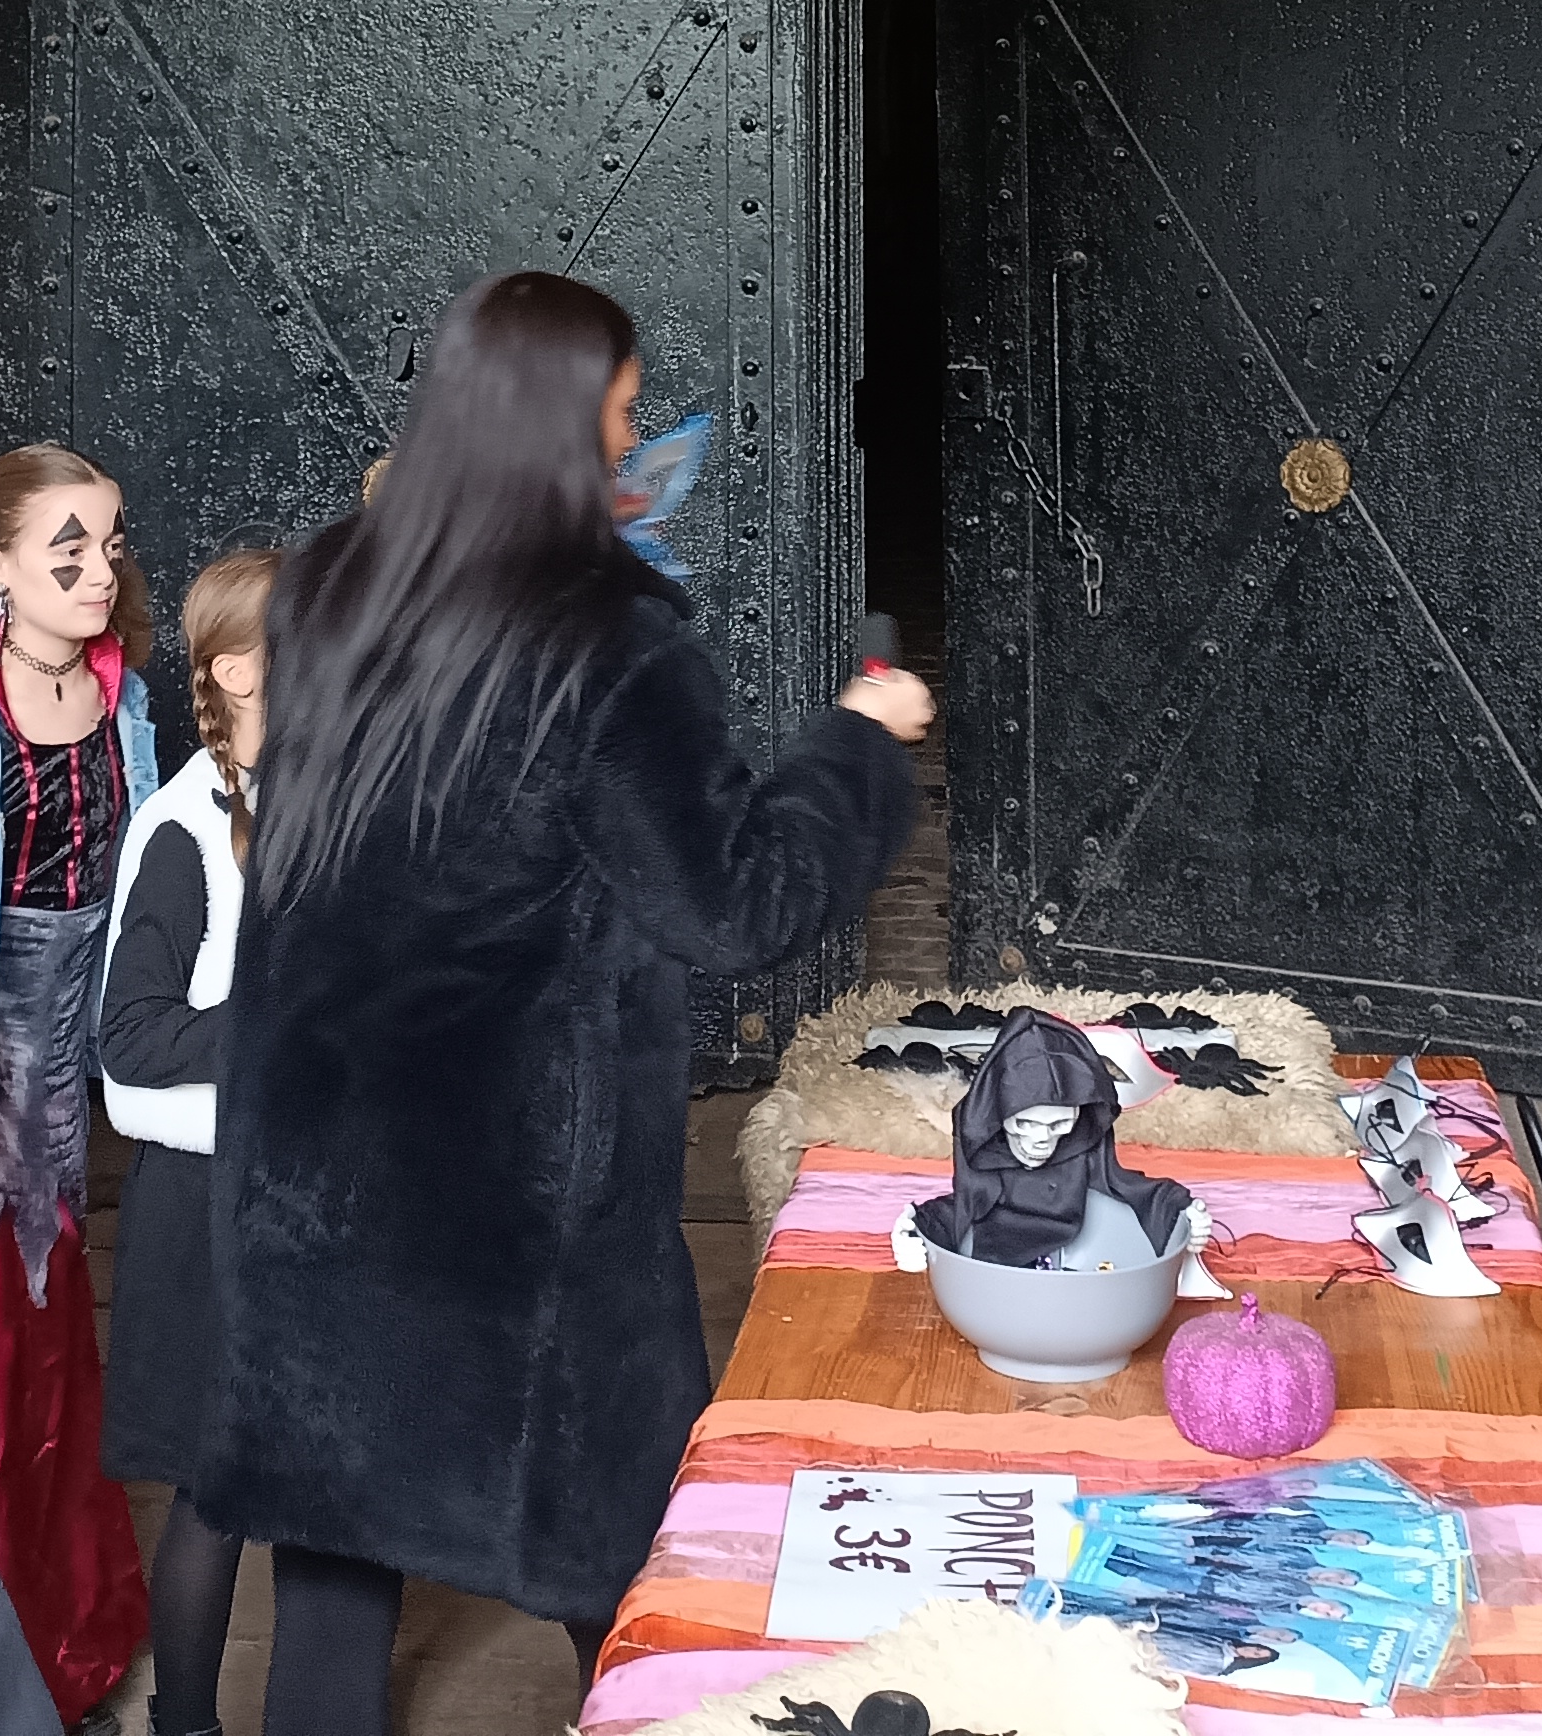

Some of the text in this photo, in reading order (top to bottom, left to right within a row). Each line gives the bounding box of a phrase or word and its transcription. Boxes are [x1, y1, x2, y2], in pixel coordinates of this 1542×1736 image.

[828, 1524, 912, 1574] 3€
[1431, 1561, 1451, 1606] PONCHO
[1368, 1630, 1399, 1674] PONCHO
[1413, 1613, 1448, 1660] PONCHO
